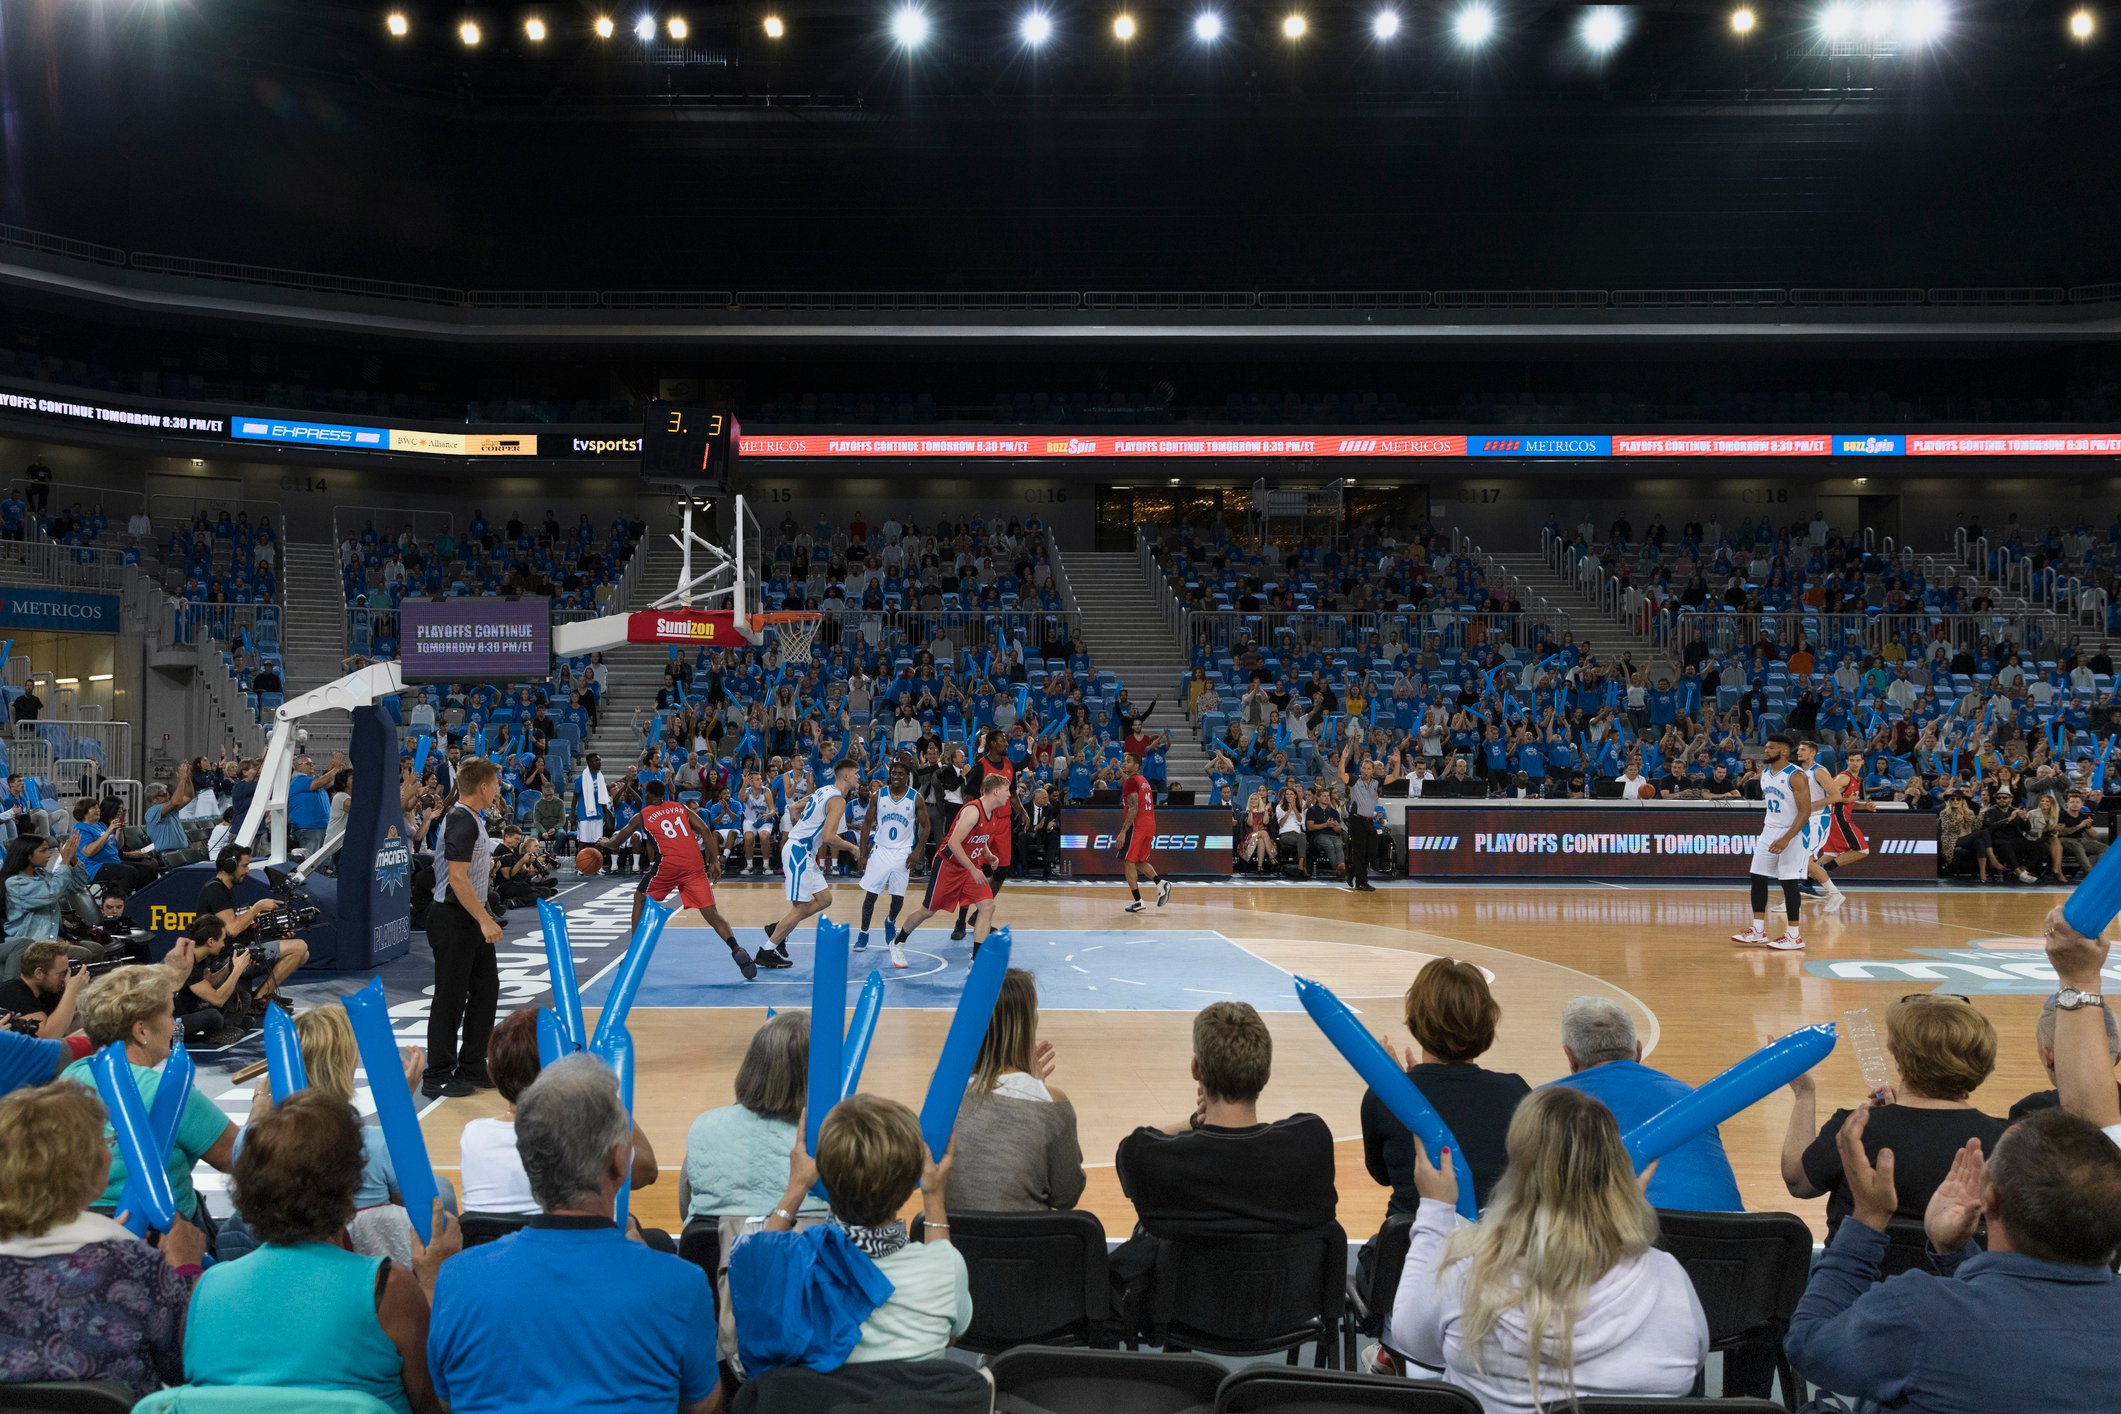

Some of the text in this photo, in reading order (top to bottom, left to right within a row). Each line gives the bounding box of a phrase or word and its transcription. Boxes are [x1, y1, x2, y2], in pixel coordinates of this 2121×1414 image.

[39, 400, 94, 418] CONTINUE
[95, 408, 161, 427] TOMORROW
[162, 416, 188, 429] 8:30
[189, 418, 223, 432] PM/ET
[272, 425, 352, 442] EXPRESS
[428, 440, 458, 449] Alliance
[739, 440, 807, 452] METRICOS
[829, 441, 1029, 452] PLAYOFFS CONTINUE TOMORROW 8:30 PM/ET
[1114, 441, 1315, 452] PLAYOFFS CONTINUE TOMORROW 8:30 PM/ET
[1381, 440, 1451, 452] METRICOS
[1525, 440, 1596, 452] METRICOS
[1619, 440, 1825, 452] PLAYOFFS CONTINUE TOMORROW 8:30 PM/ET
[1913, 440, 2121, 451] PLAYOFFS CONTINUE TOMORROW 8:30 PM/ET
[12, 600, 102, 619] METRICOS
[417, 625, 533, 639] PLAYOFFS CONTINUE
[656, 618, 714, 636] Sumizon
[416, 641, 534, 654] TOMORROW 8:30 PM/ET
[1767, 799, 1781, 813] 42
[660, 816, 689, 839] 81
[888, 826, 898, 841] 0
[1093, 835, 1199, 850] EXESS
[1474, 833, 1760, 855] PLAYOFFS CONTINUE TOMORROW
[377, 850, 408, 868] MAGNETS
[374, 916, 409, 953] PLAYOFFS
